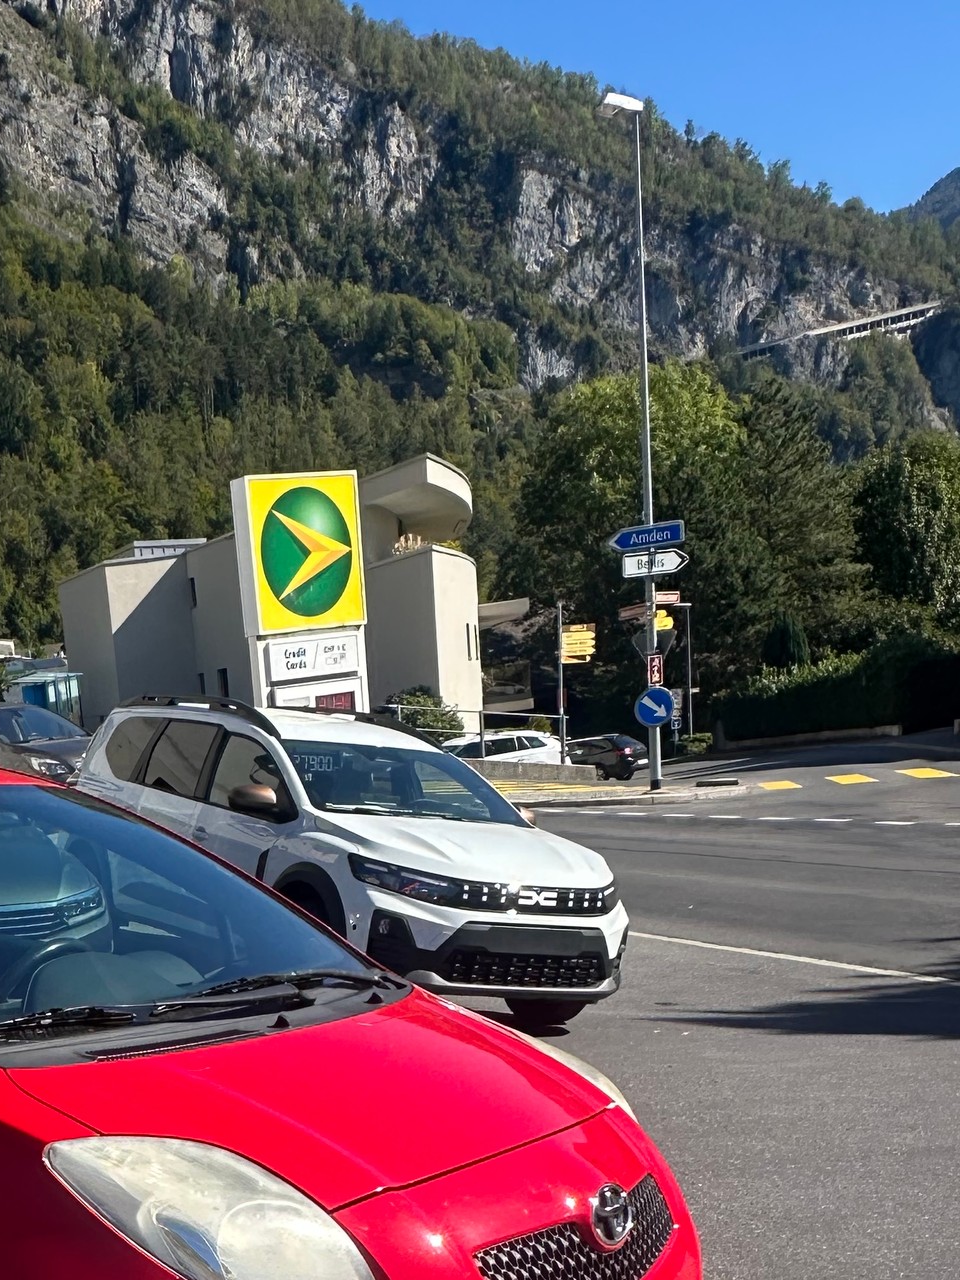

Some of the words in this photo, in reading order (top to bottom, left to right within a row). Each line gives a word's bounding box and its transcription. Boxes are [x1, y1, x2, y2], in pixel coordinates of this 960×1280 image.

[630, 529, 671, 545] Amden
[637, 558, 665, 571] Belis
[285, 660, 307, 670] Cards
